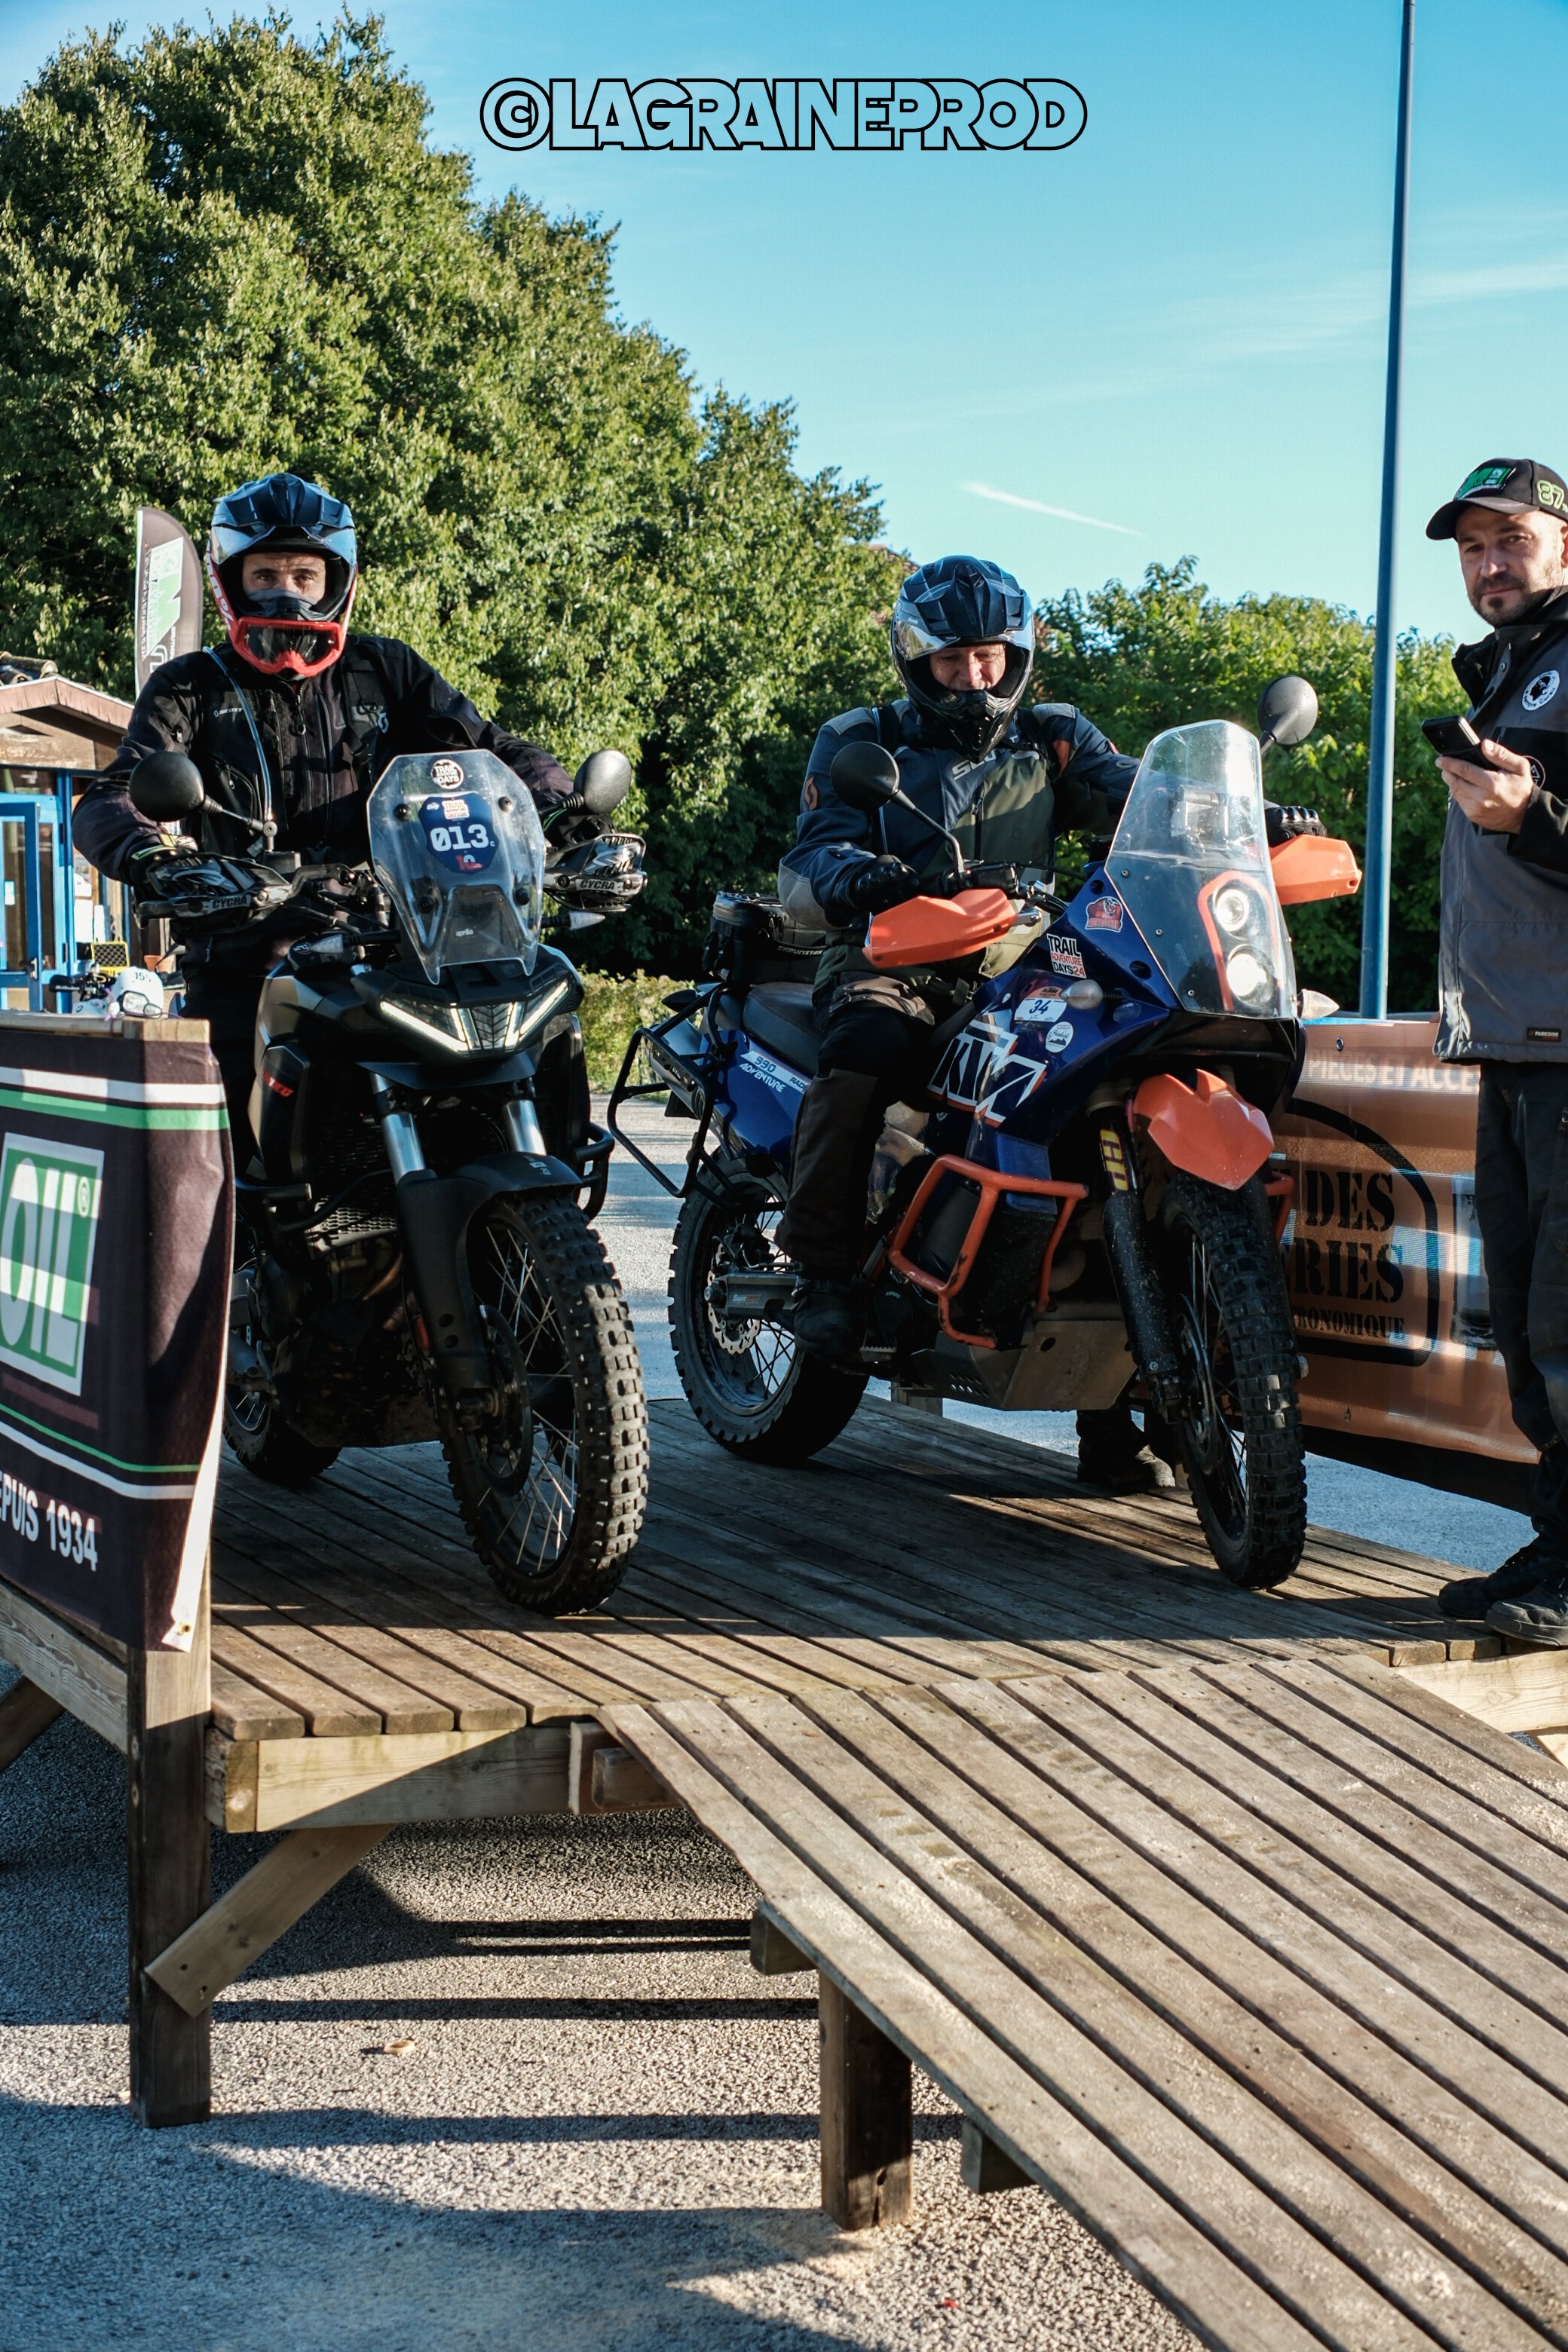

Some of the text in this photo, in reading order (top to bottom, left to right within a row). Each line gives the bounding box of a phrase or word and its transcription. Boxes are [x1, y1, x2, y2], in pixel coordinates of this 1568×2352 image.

[1536, 479, 1565, 510] 87
[430, 824, 489, 852] 013
[580, 879, 615, 890] CYCRA
[212, 896, 248, 909] CYCRA
[1048, 935, 1081, 957] TRAIL
[1051, 952, 1083, 966] ADVENTURE
[1028, 999, 1052, 1015] 34
[739, 1061, 786, 1093] ADVENTURE
[755, 1055, 777, 1073] 990
[926, 1019, 1048, 1125] KTM
[1410, 1058, 1480, 1093] ACCE
[1305, 1169, 1395, 1232] DES
[1282, 1237, 1404, 1303] RIES
[46, 1499, 99, 1573] 1934
